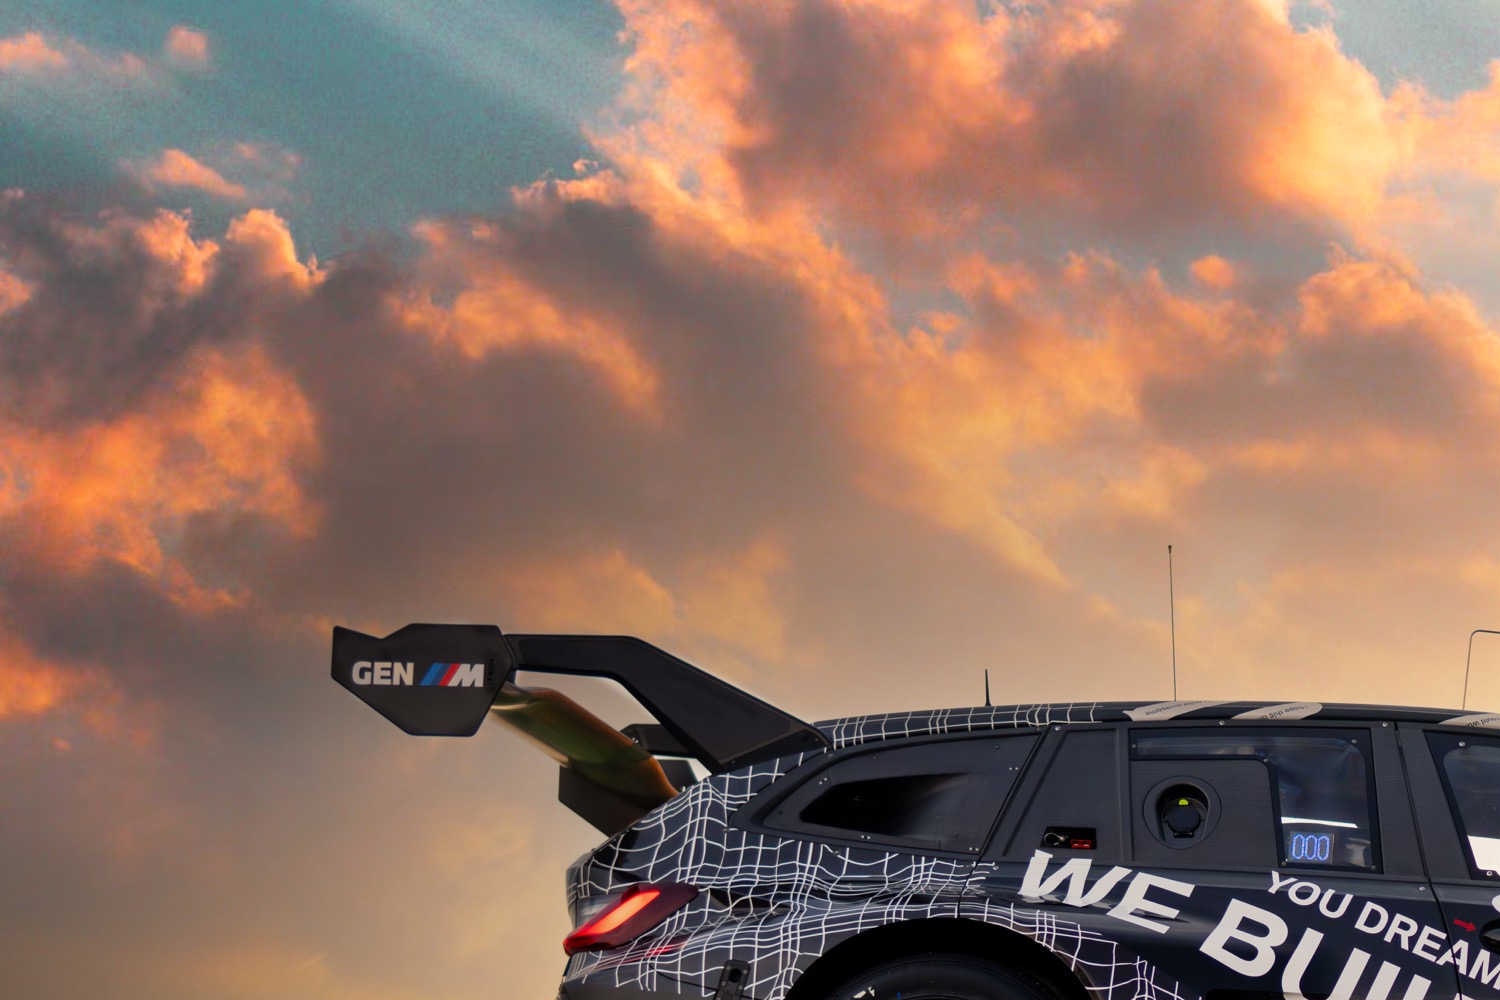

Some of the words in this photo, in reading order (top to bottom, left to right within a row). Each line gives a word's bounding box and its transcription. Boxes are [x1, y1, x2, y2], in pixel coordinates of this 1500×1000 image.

[352, 661, 414, 686] GEN
[447, 663, 485, 688] M
[1269, 708, 1284, 720] this
[1017, 849, 1195, 935] WE
[1268, 871, 1353, 918] YOU
